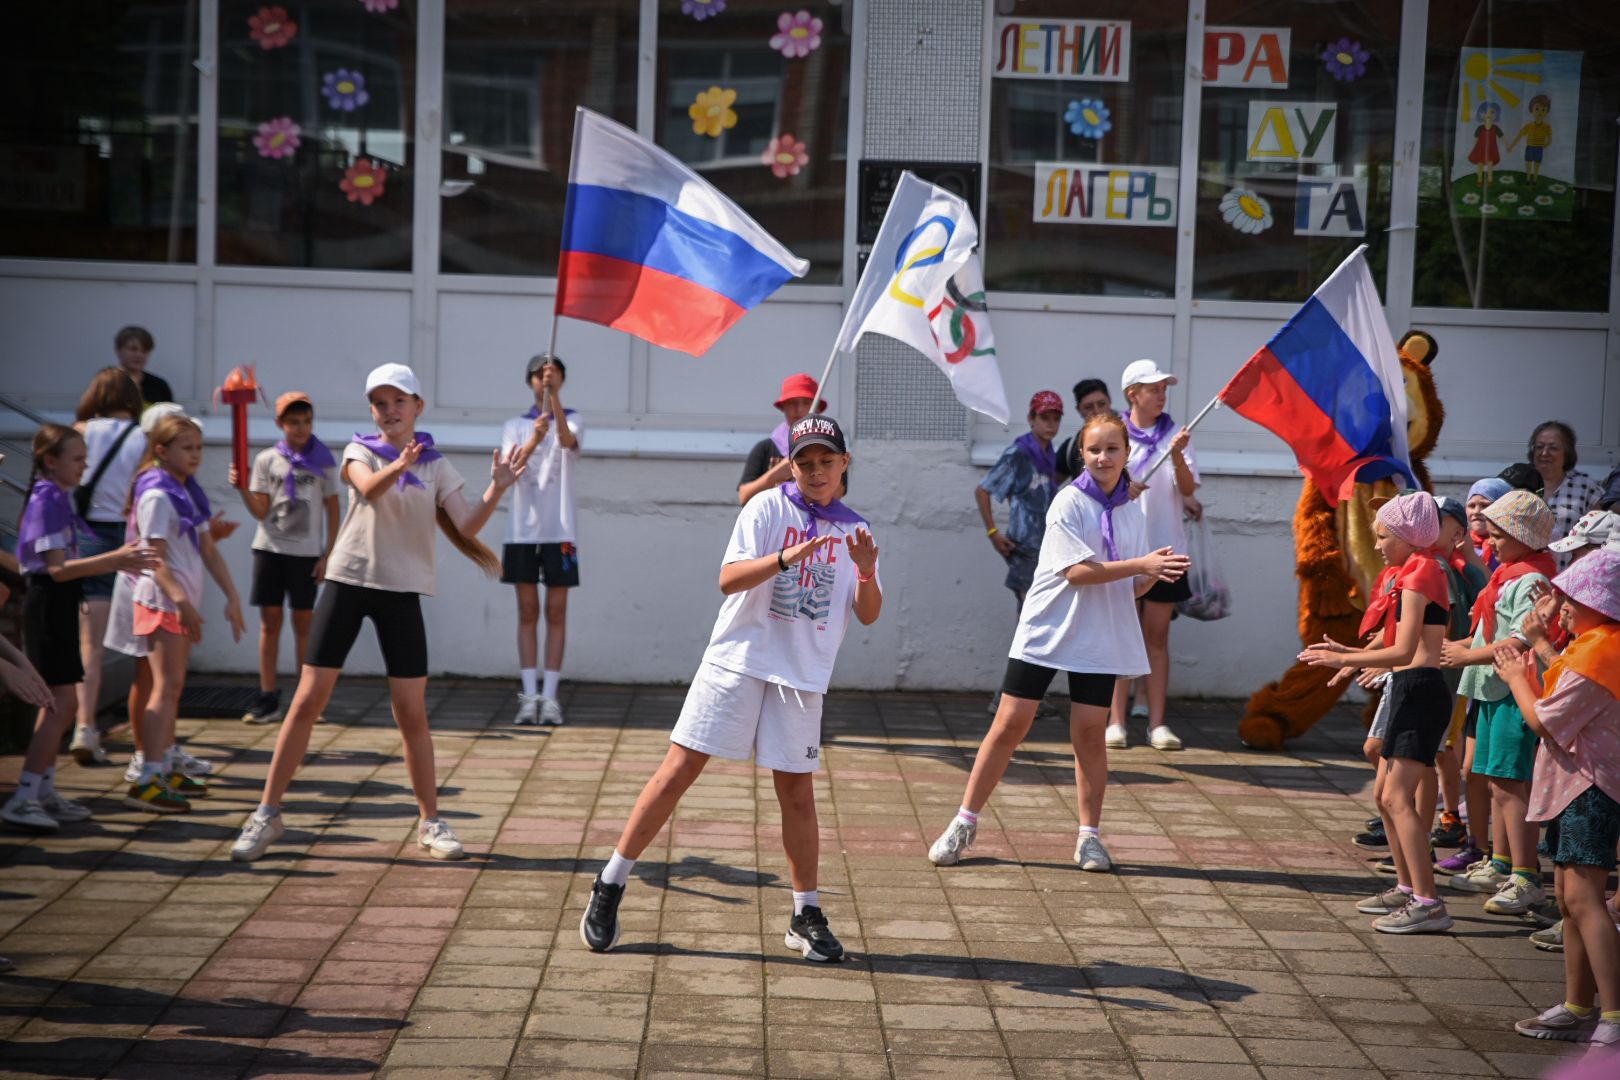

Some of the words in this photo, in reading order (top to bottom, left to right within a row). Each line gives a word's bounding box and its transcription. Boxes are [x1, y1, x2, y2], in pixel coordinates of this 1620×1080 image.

[996, 22, 1123, 76] ЛЕТНИЙ
[1202, 32, 1289, 84] РА
[1248, 107, 1336, 160] ДУ
[1042, 168, 1172, 221] ЛАГЕРЬ
[1295, 181, 1364, 231] ГА
[815, 419, 835, 434] YORK
